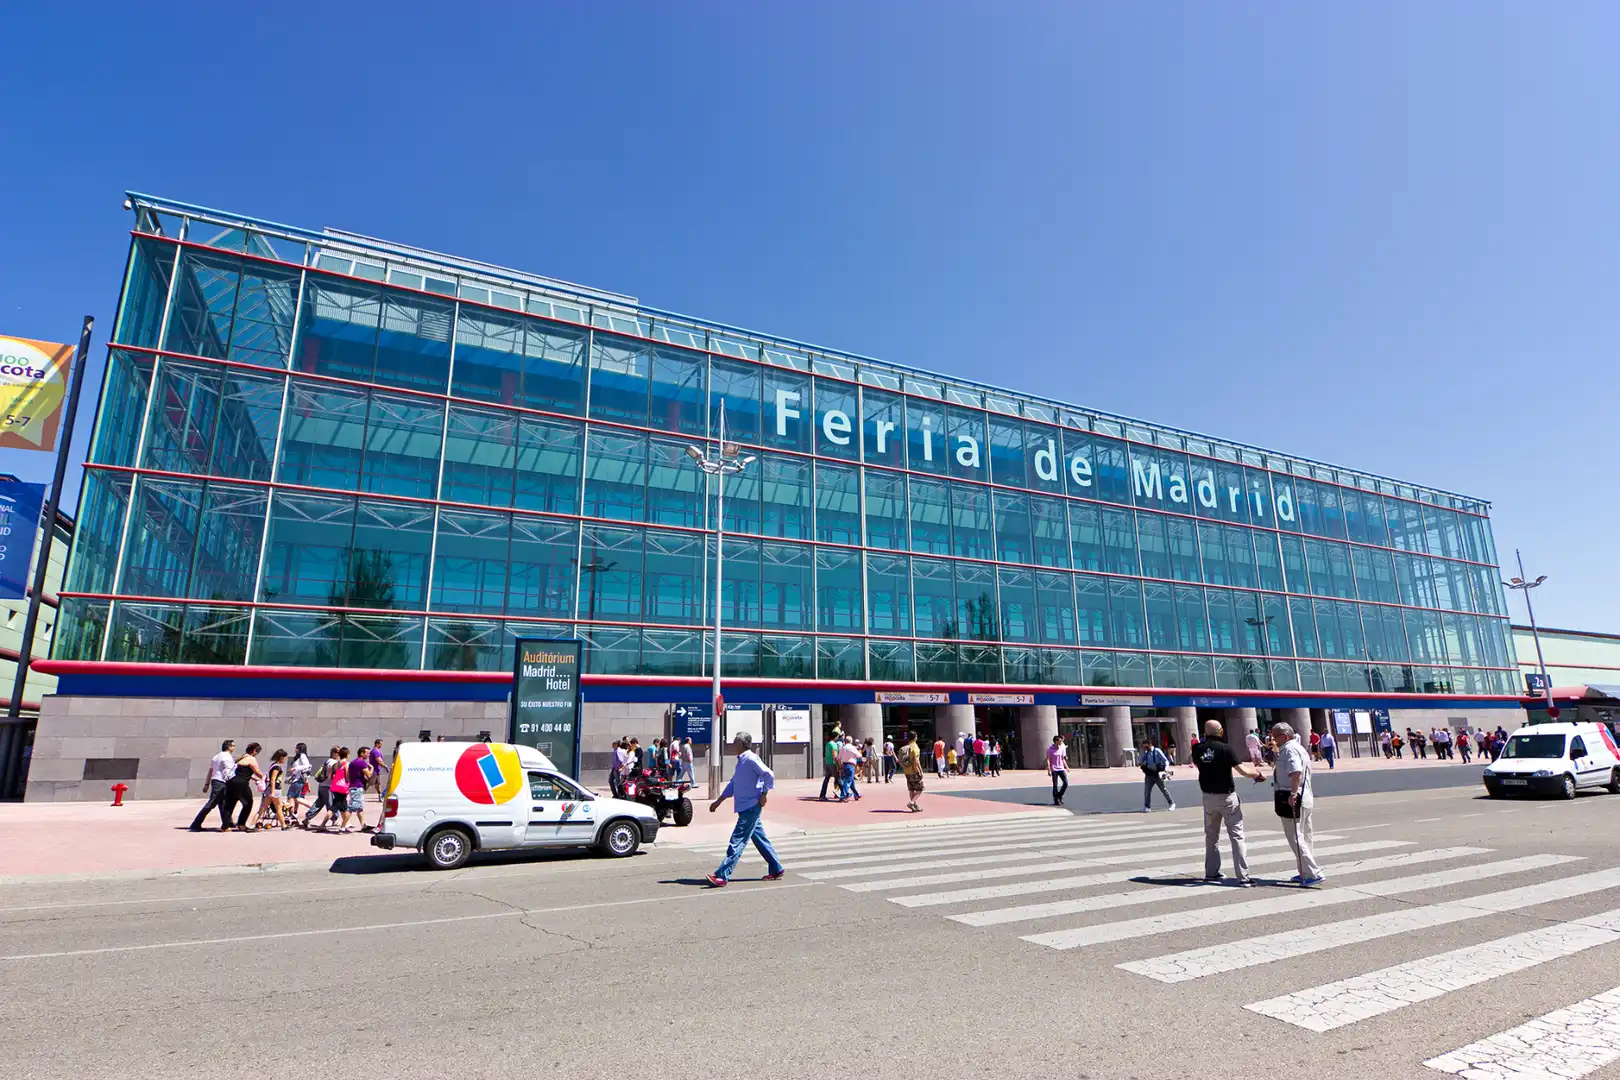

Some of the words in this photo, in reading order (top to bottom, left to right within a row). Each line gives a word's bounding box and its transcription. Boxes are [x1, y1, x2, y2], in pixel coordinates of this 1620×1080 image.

[0, 365, 46, 379] cota
[5, 415, 31, 427] 5-7
[775, 389, 980, 468] Feria
[1034, 439, 1092, 487] de
[1132, 459, 1295, 521] Madrid
[523, 651, 575, 663] Auditórium
[546, 678, 571, 690] Hotel
[530, 723, 539, 733] 91
[553, 723, 562, 733] 44
